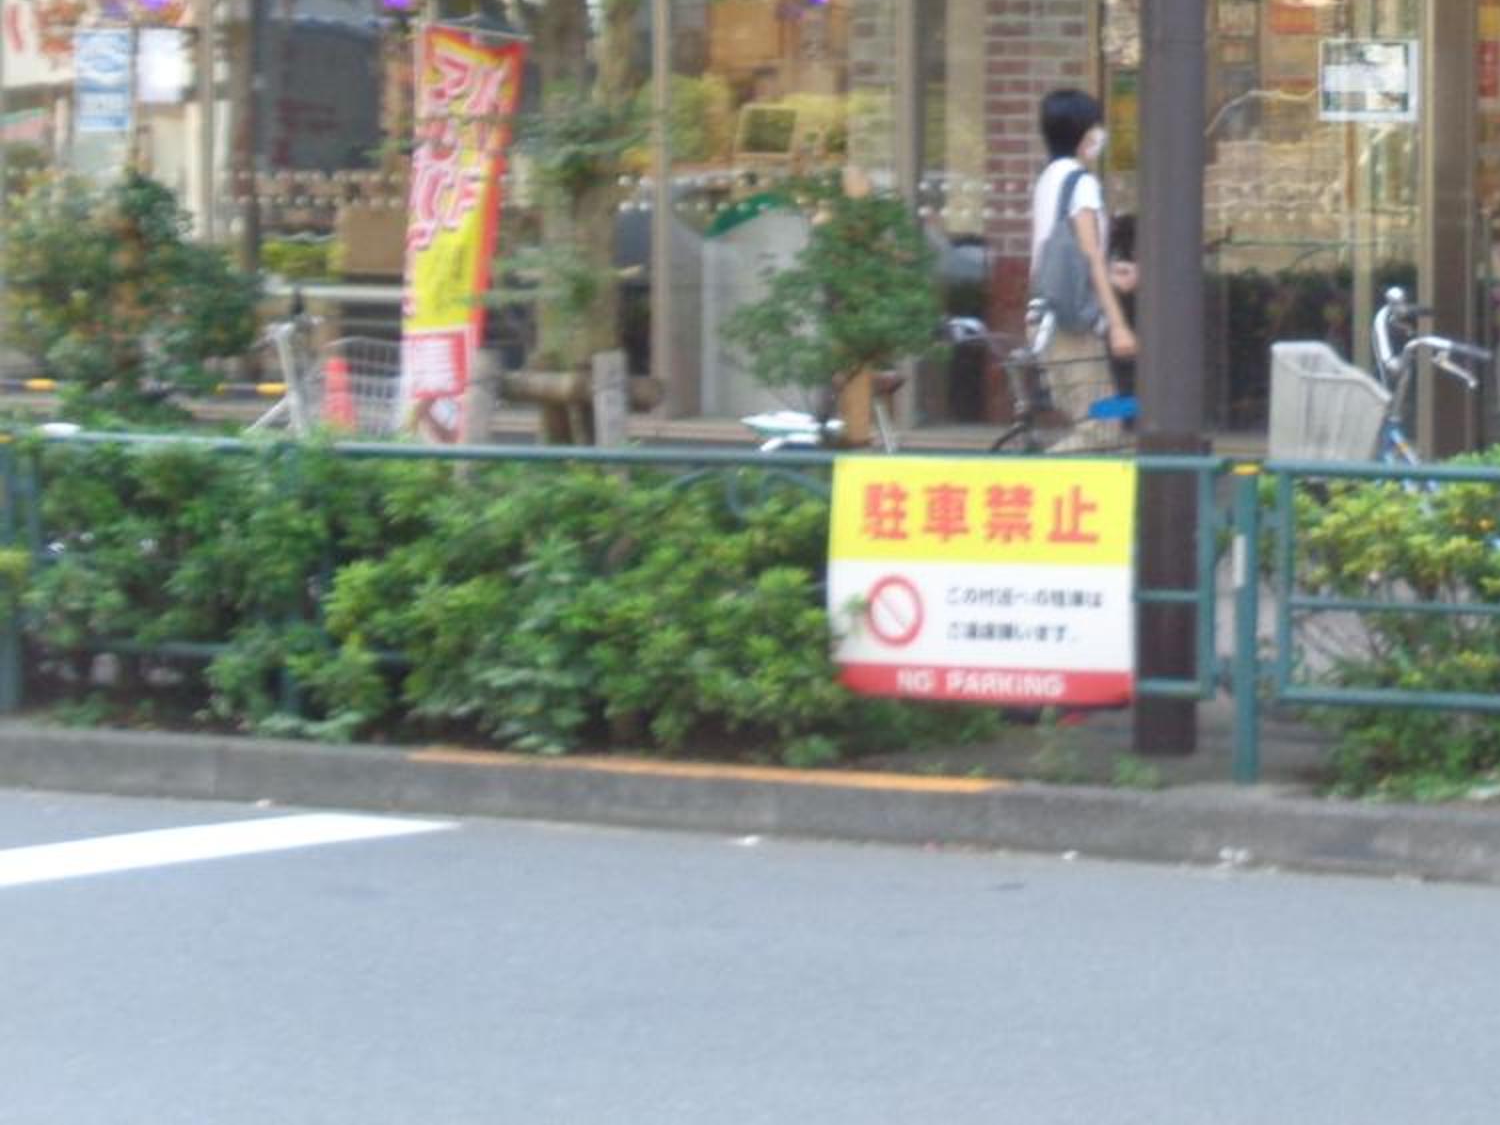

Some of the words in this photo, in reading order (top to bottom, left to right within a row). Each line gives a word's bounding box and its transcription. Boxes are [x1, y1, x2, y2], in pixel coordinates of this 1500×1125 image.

[862, 483, 1099, 542] 駐車禁止
[897, 668, 933, 693] NO
[946, 669, 1066, 698] PARKING
